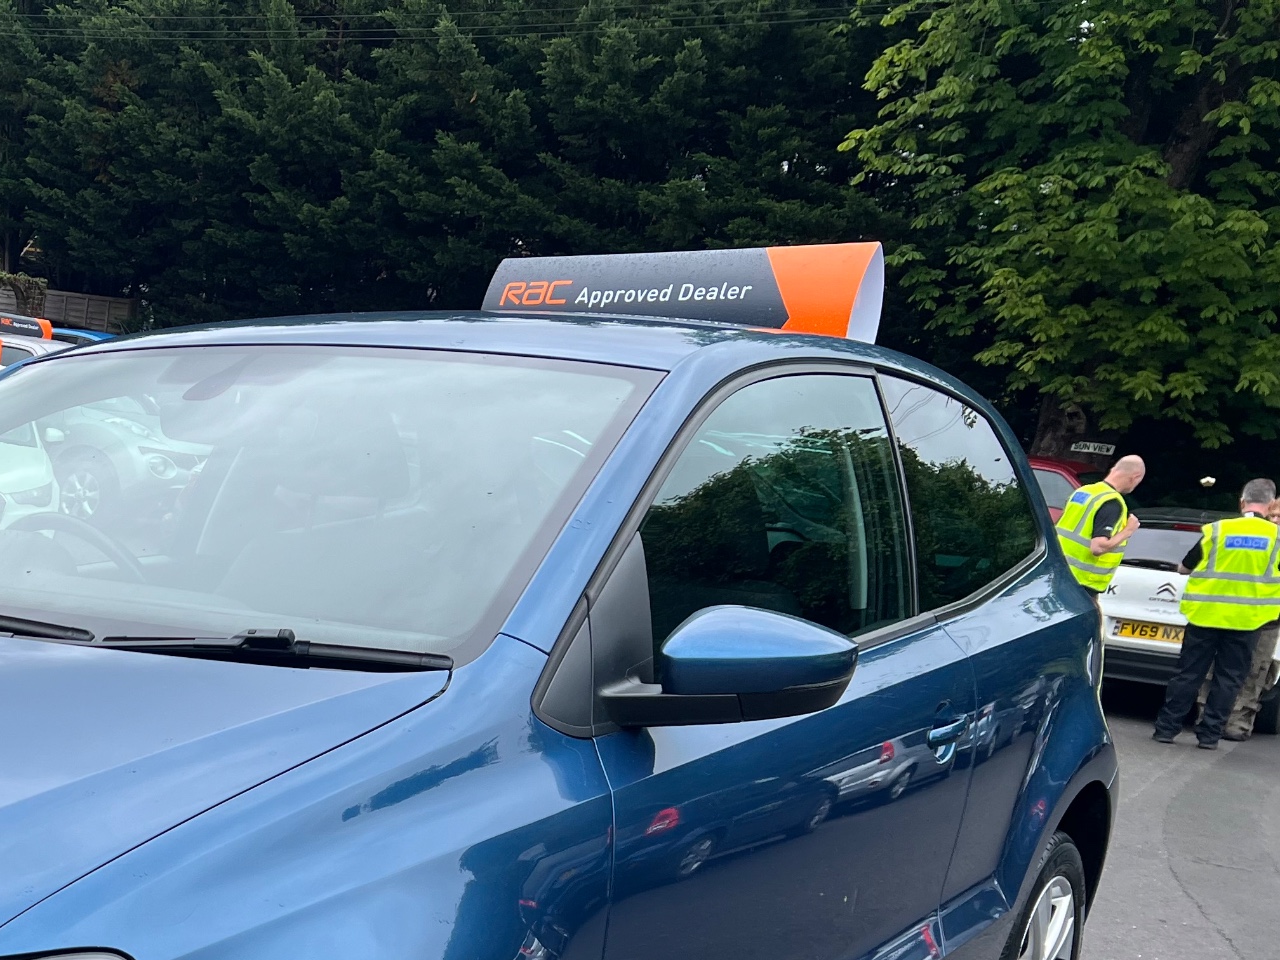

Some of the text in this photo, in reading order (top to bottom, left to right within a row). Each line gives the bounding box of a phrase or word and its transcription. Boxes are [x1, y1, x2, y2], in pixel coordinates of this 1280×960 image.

[499, 280, 753, 308] RAC Approved Dealer
[1226, 537, 1268, 549] POLICE
[1120, 622, 1184, 641] FV69 NX
